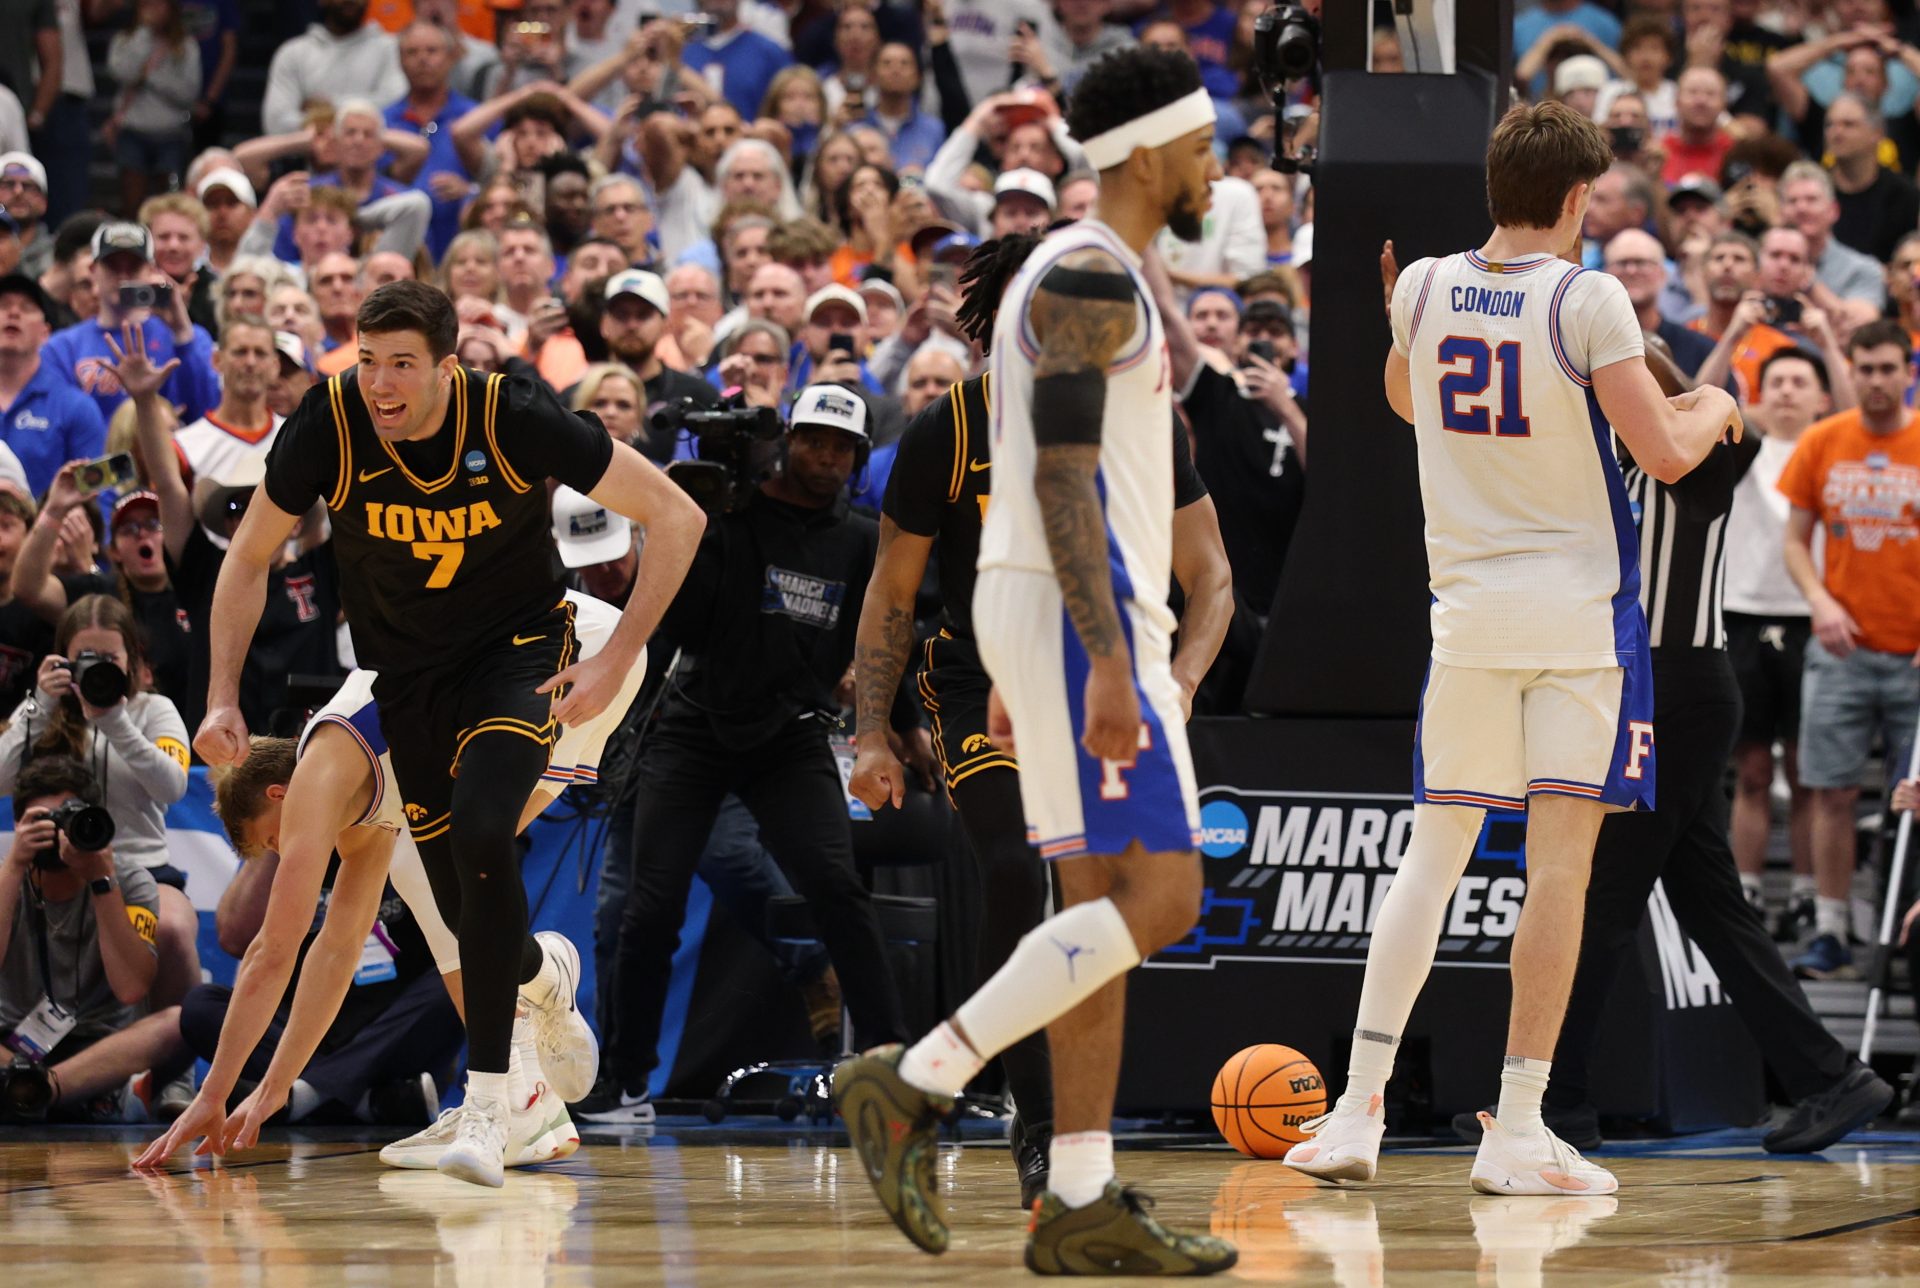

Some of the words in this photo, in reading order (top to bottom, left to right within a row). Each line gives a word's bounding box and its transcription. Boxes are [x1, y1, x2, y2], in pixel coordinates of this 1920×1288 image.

[1451, 286, 1526, 318] CONDON
[1437, 335, 1531, 437] 21
[365, 500, 502, 542] IOWA
[411, 541, 465, 589] 7
[778, 573, 826, 601] MARCH
[780, 590, 841, 622] MADNES
[1624, 719, 1655, 780] F
[1201, 827, 1247, 845] NCAA
[1249, 805, 1414, 868] MARC
